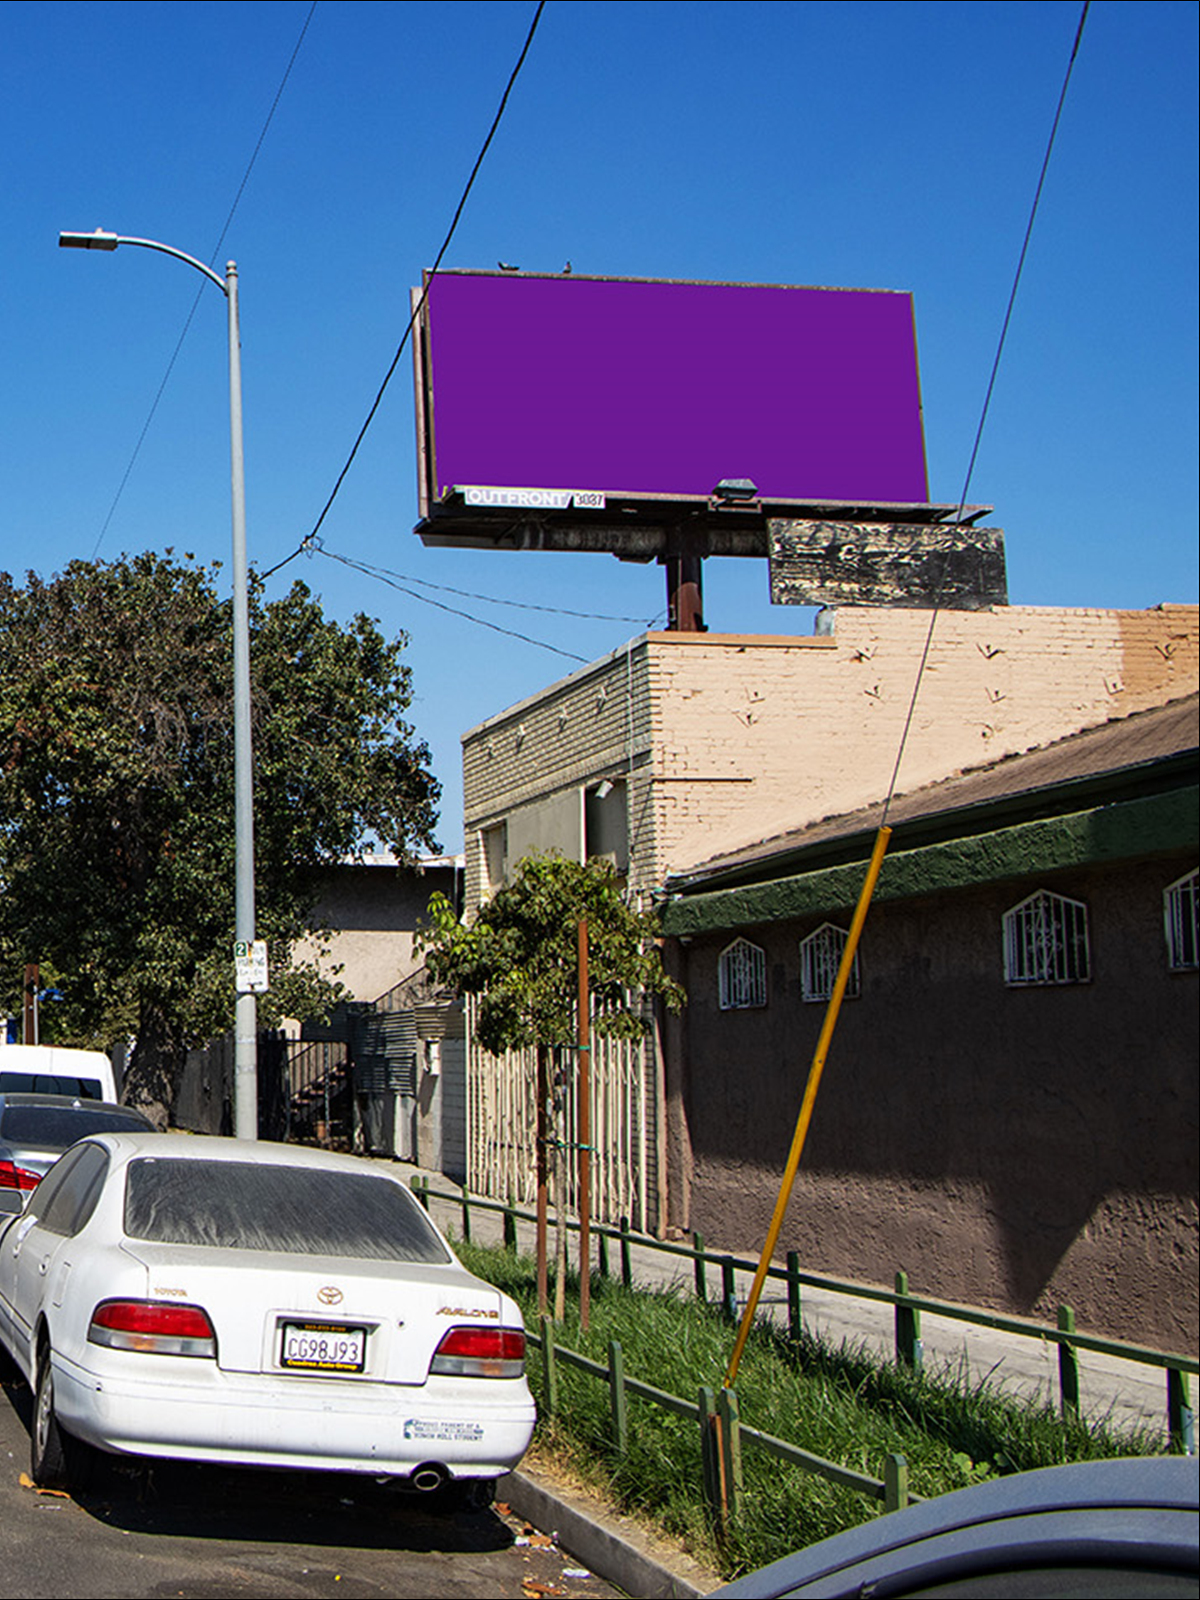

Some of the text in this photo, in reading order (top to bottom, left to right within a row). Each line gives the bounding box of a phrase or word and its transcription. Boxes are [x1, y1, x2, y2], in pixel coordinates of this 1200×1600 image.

[468, 489, 568, 506] OUTFRONT
[237, 943, 245, 956] 2
[288, 1338, 358, 1362] CG98J93
[318, 1361, 335, 1369] Auto
[335, 1362, 358, 1371] Group
